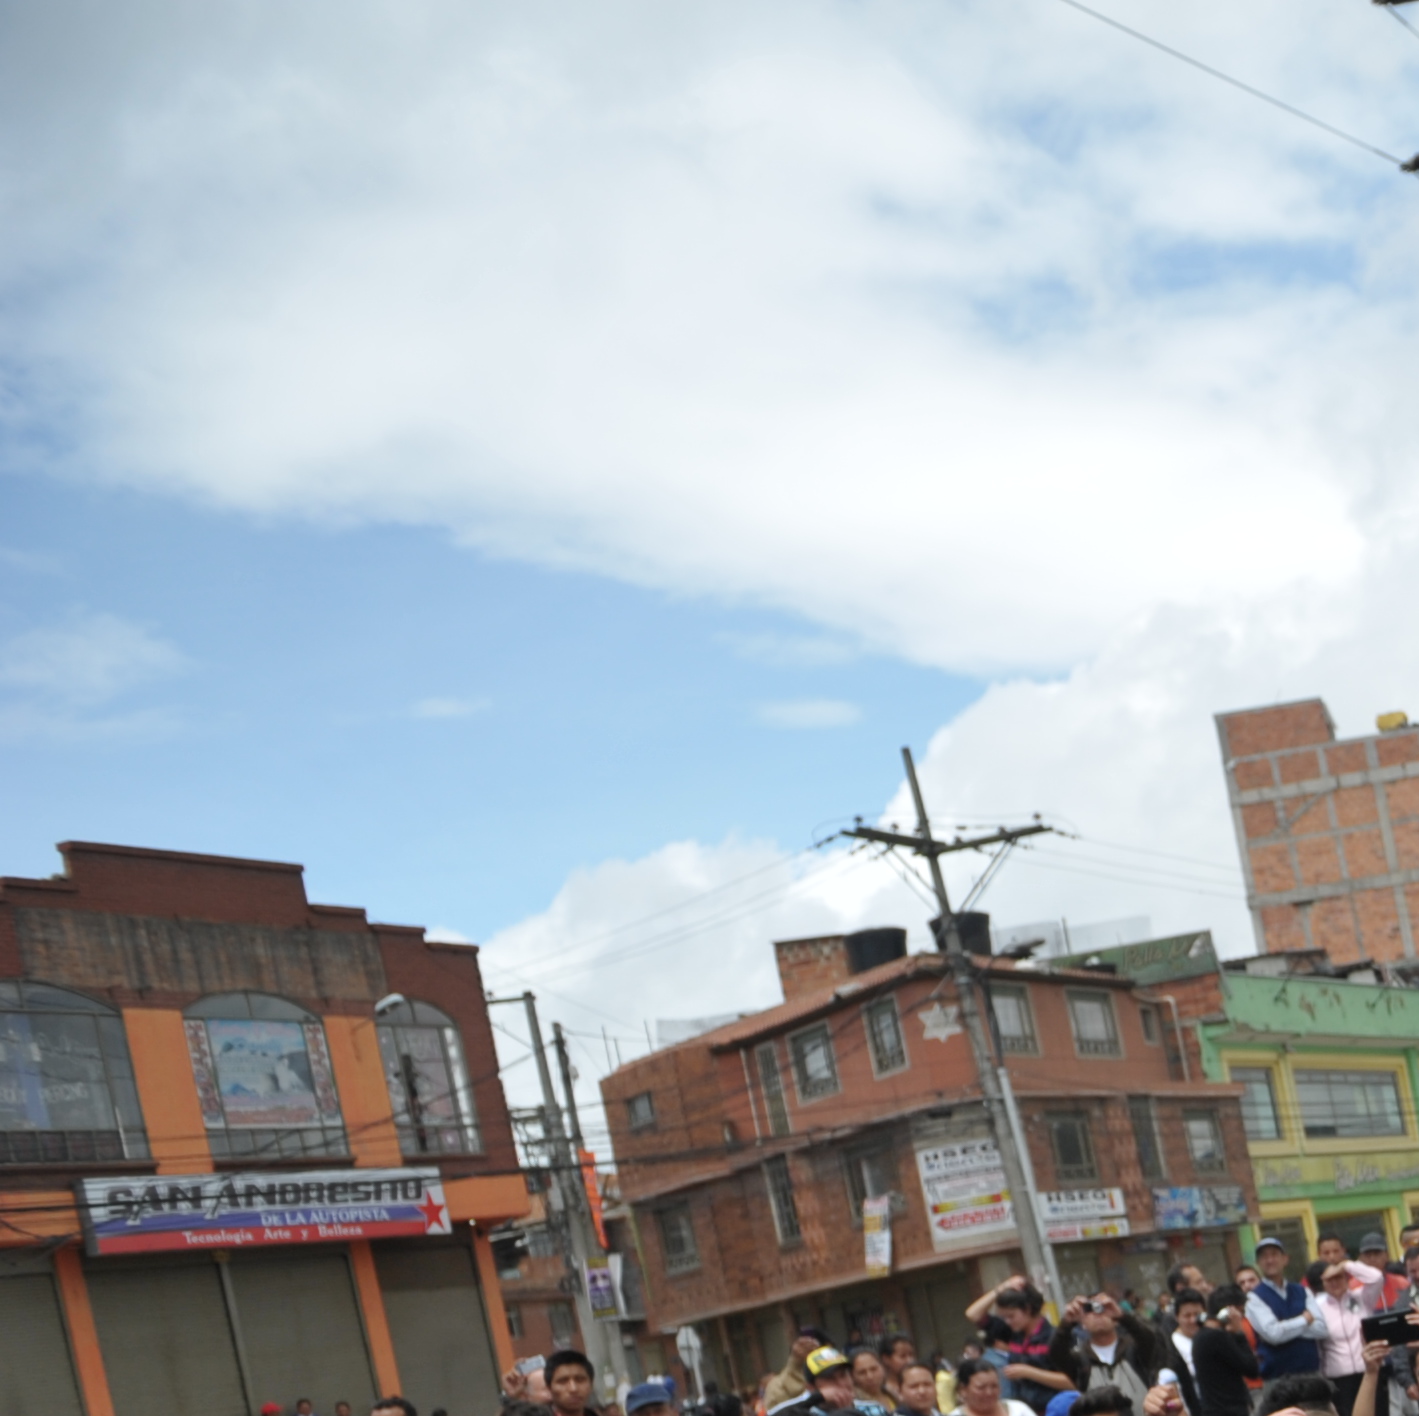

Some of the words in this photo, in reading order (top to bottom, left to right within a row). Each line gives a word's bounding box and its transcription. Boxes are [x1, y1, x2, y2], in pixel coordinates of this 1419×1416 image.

[260, 1211, 287, 1227] DE
[288, 1210, 306, 1225] LA
[308, 1207, 390, 1225] AUTOPISTA
[263, 1226, 291, 1240] Arte
[300, 1228, 309, 1240] y
[318, 1223, 363, 1238] Belleza
